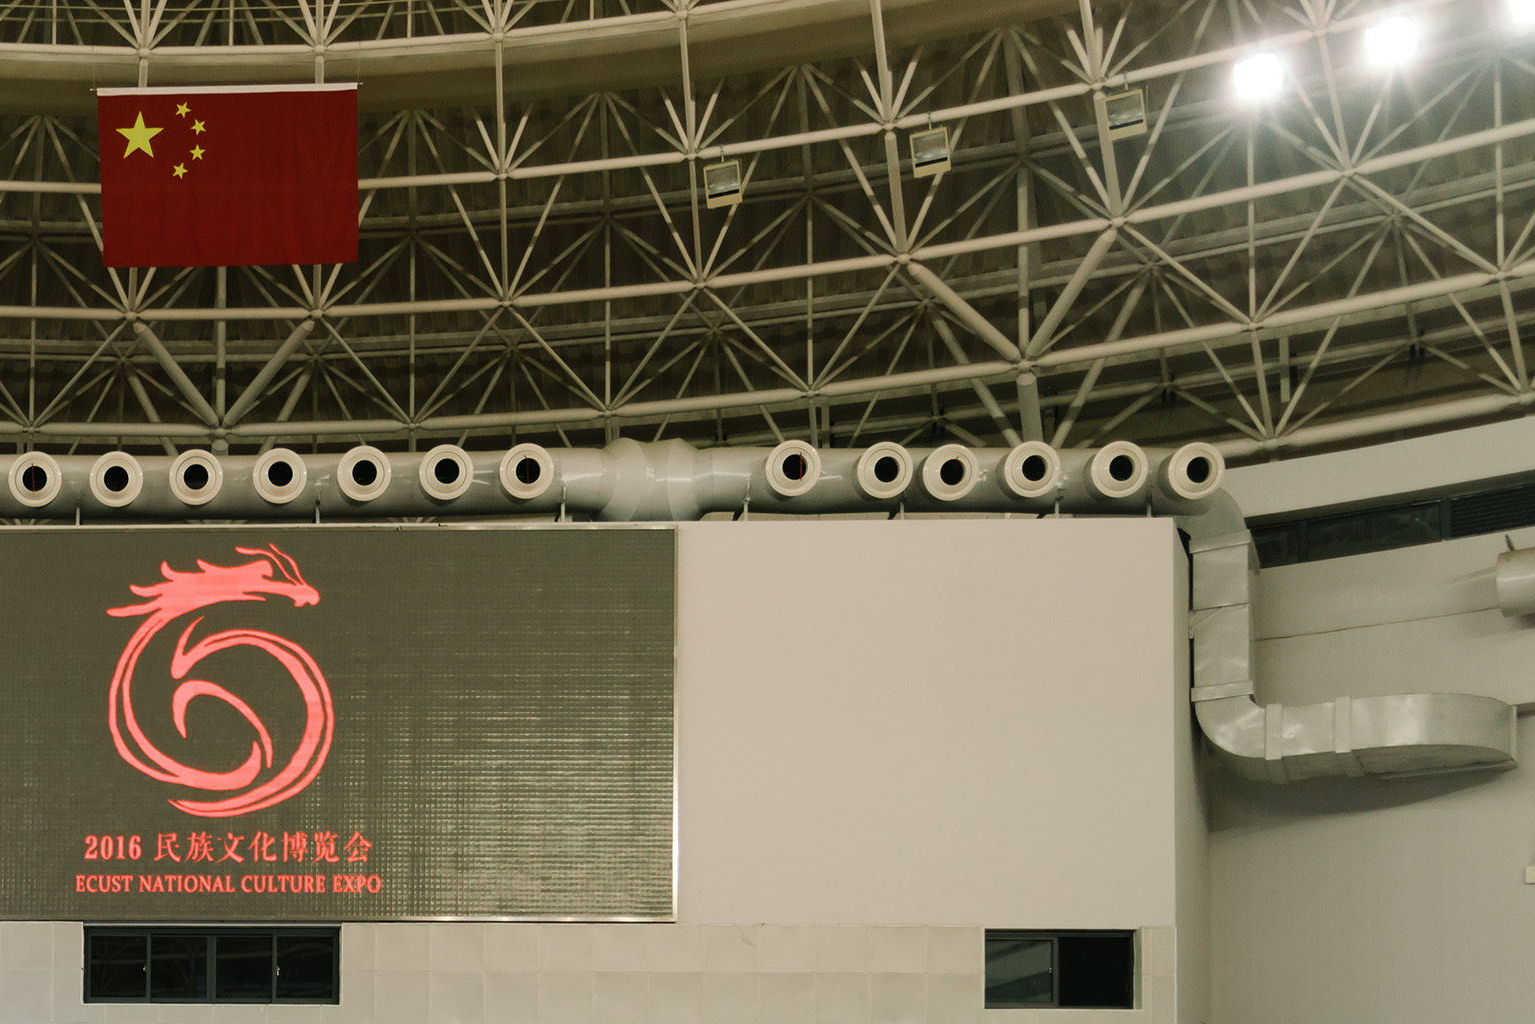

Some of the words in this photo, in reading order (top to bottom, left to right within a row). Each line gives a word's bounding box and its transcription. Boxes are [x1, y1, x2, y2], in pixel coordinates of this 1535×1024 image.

[84, 835, 142, 860] 2016
[154, 831, 372, 863] 民族文化博览会
[75, 874, 133, 893] ECUST
[139, 874, 235, 893] NATIONAL
[241, 874, 326, 893] CULTURE
[332, 874, 382, 893] EXPO
